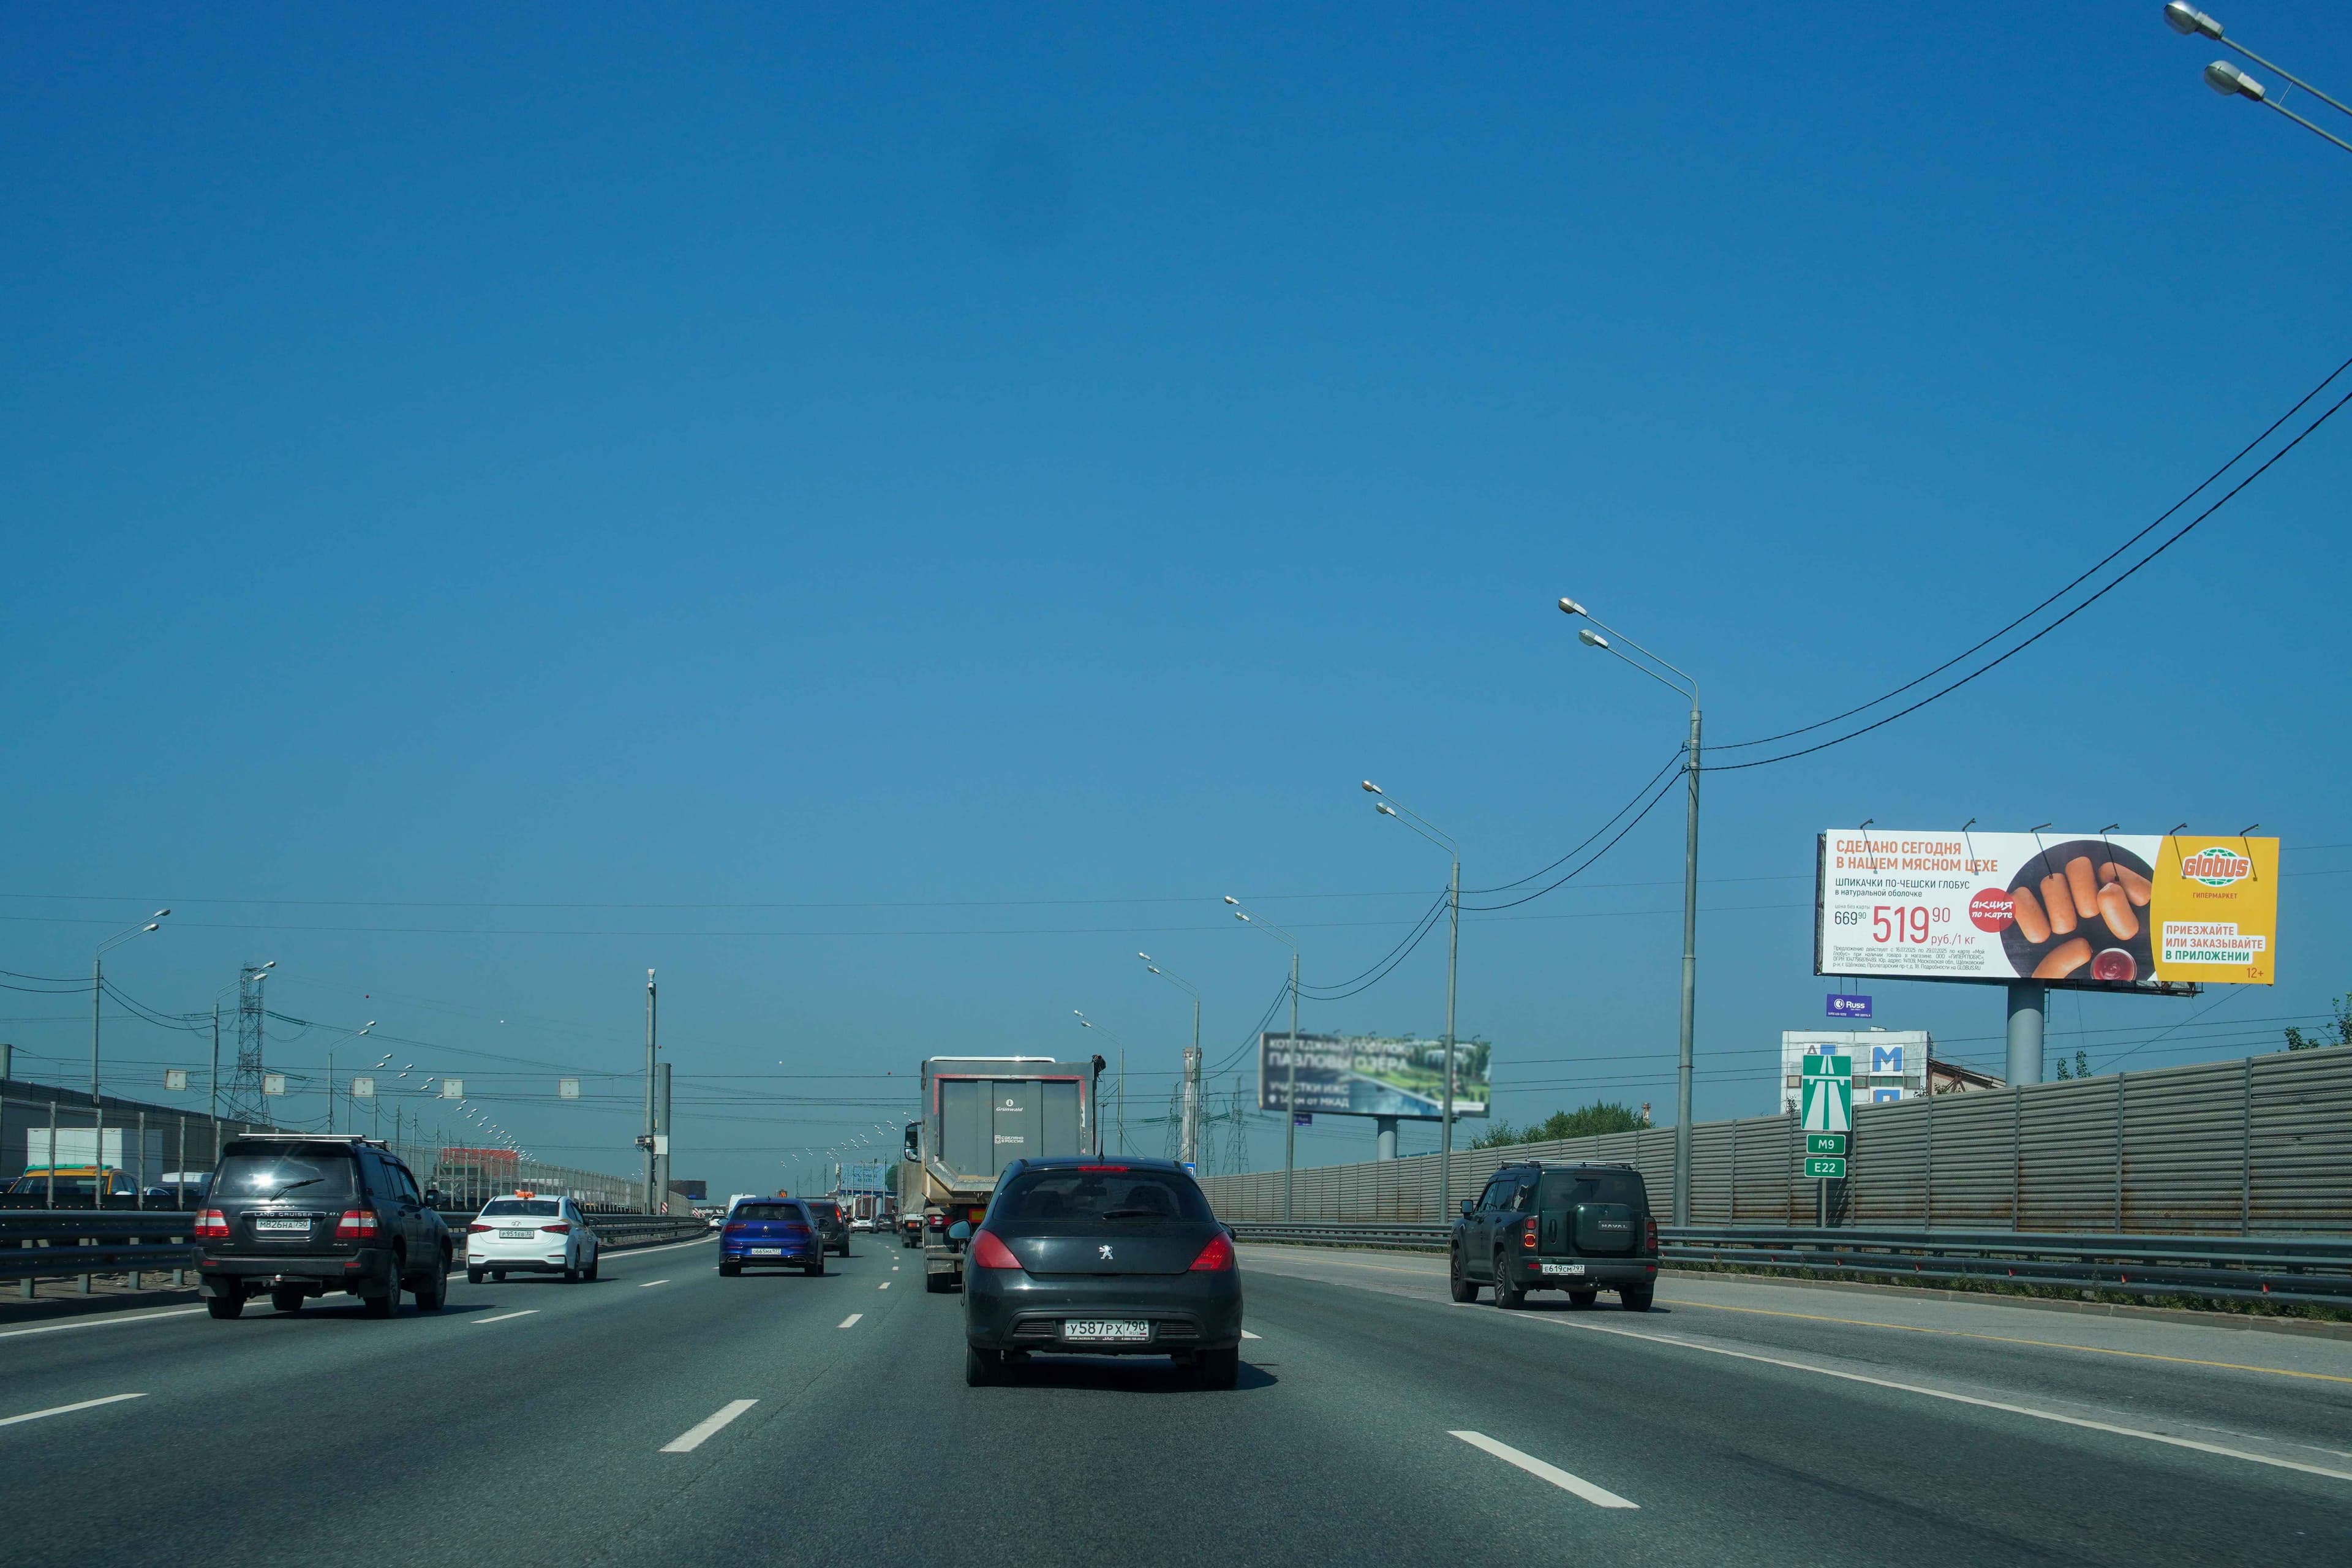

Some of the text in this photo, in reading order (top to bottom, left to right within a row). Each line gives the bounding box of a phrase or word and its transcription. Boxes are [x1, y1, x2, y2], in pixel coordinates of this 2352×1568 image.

[1836, 840, 1961, 856] СДЕЛАНО СЕГОДНЯ
[1836, 856, 1998, 873] В НАШЕМ МЯСНОМ ЦЕХЕ
[1835, 878, 1970, 889] ШПИКАЧКИ ПО-ЧЕШСКИ ГЛОБУС
[1841, 889, 1887, 897] натуральной
[1873, 906, 1951, 944] 519 90
[2166, 924, 2234, 936] ПРИЕЗЖАЙТЕ
[1964, 937, 1975, 945] кг
[2166, 937, 2263, 949] ИЛИ ЗАКАЗЫВАЙТЕ
[2165, 950, 2250, 961] В ПРИЛОЖЕНИИ
[2247, 968, 2264, 978] 12+
[1818, 1139, 1834, 1150] М9
[1814, 1162, 1836, 1173] E22
